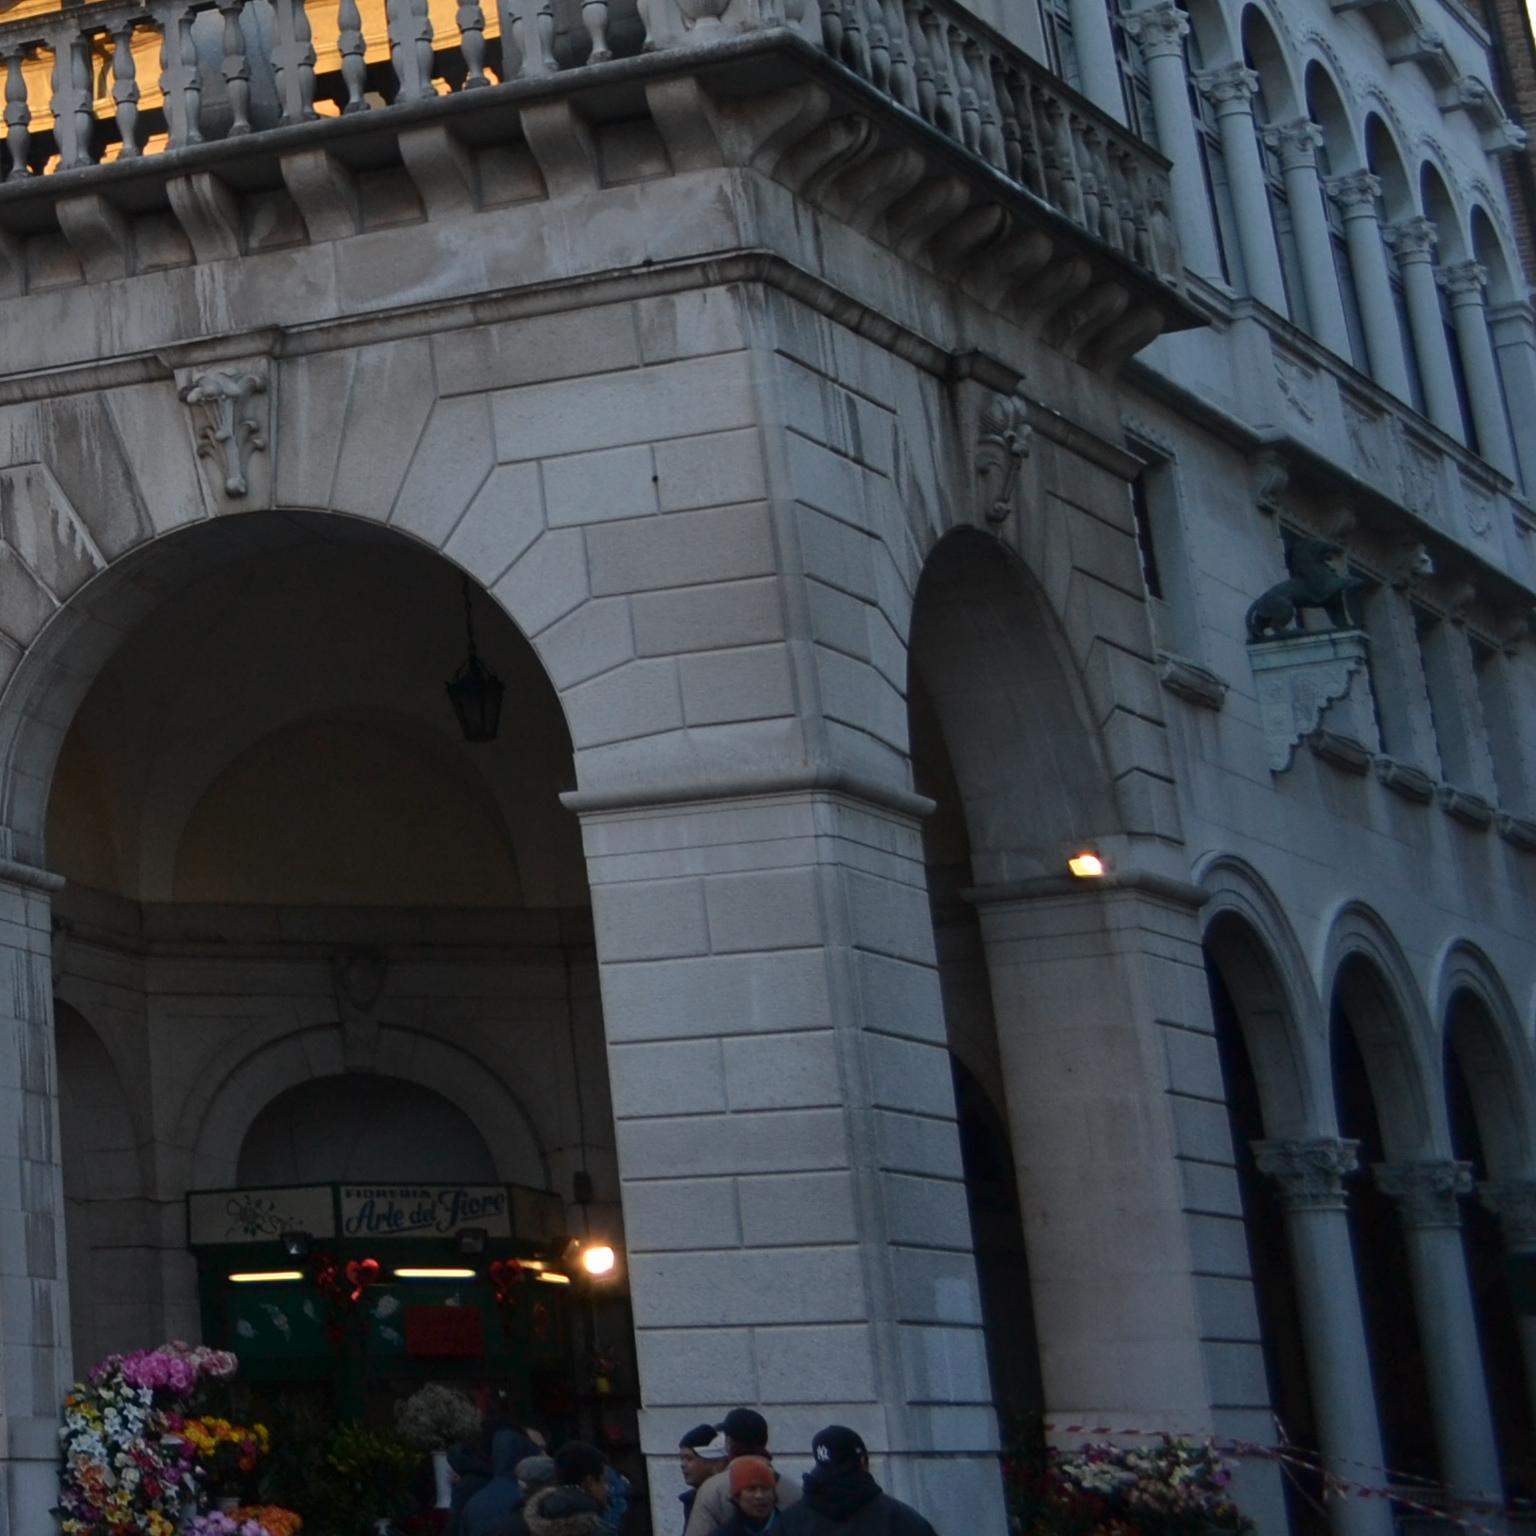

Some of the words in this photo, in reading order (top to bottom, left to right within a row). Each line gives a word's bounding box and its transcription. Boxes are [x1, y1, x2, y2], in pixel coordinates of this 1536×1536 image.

[346, 1200, 404, 1234] Arte
[409, 1199, 437, 1226] del
[436, 1189, 505, 1233] Fiore
